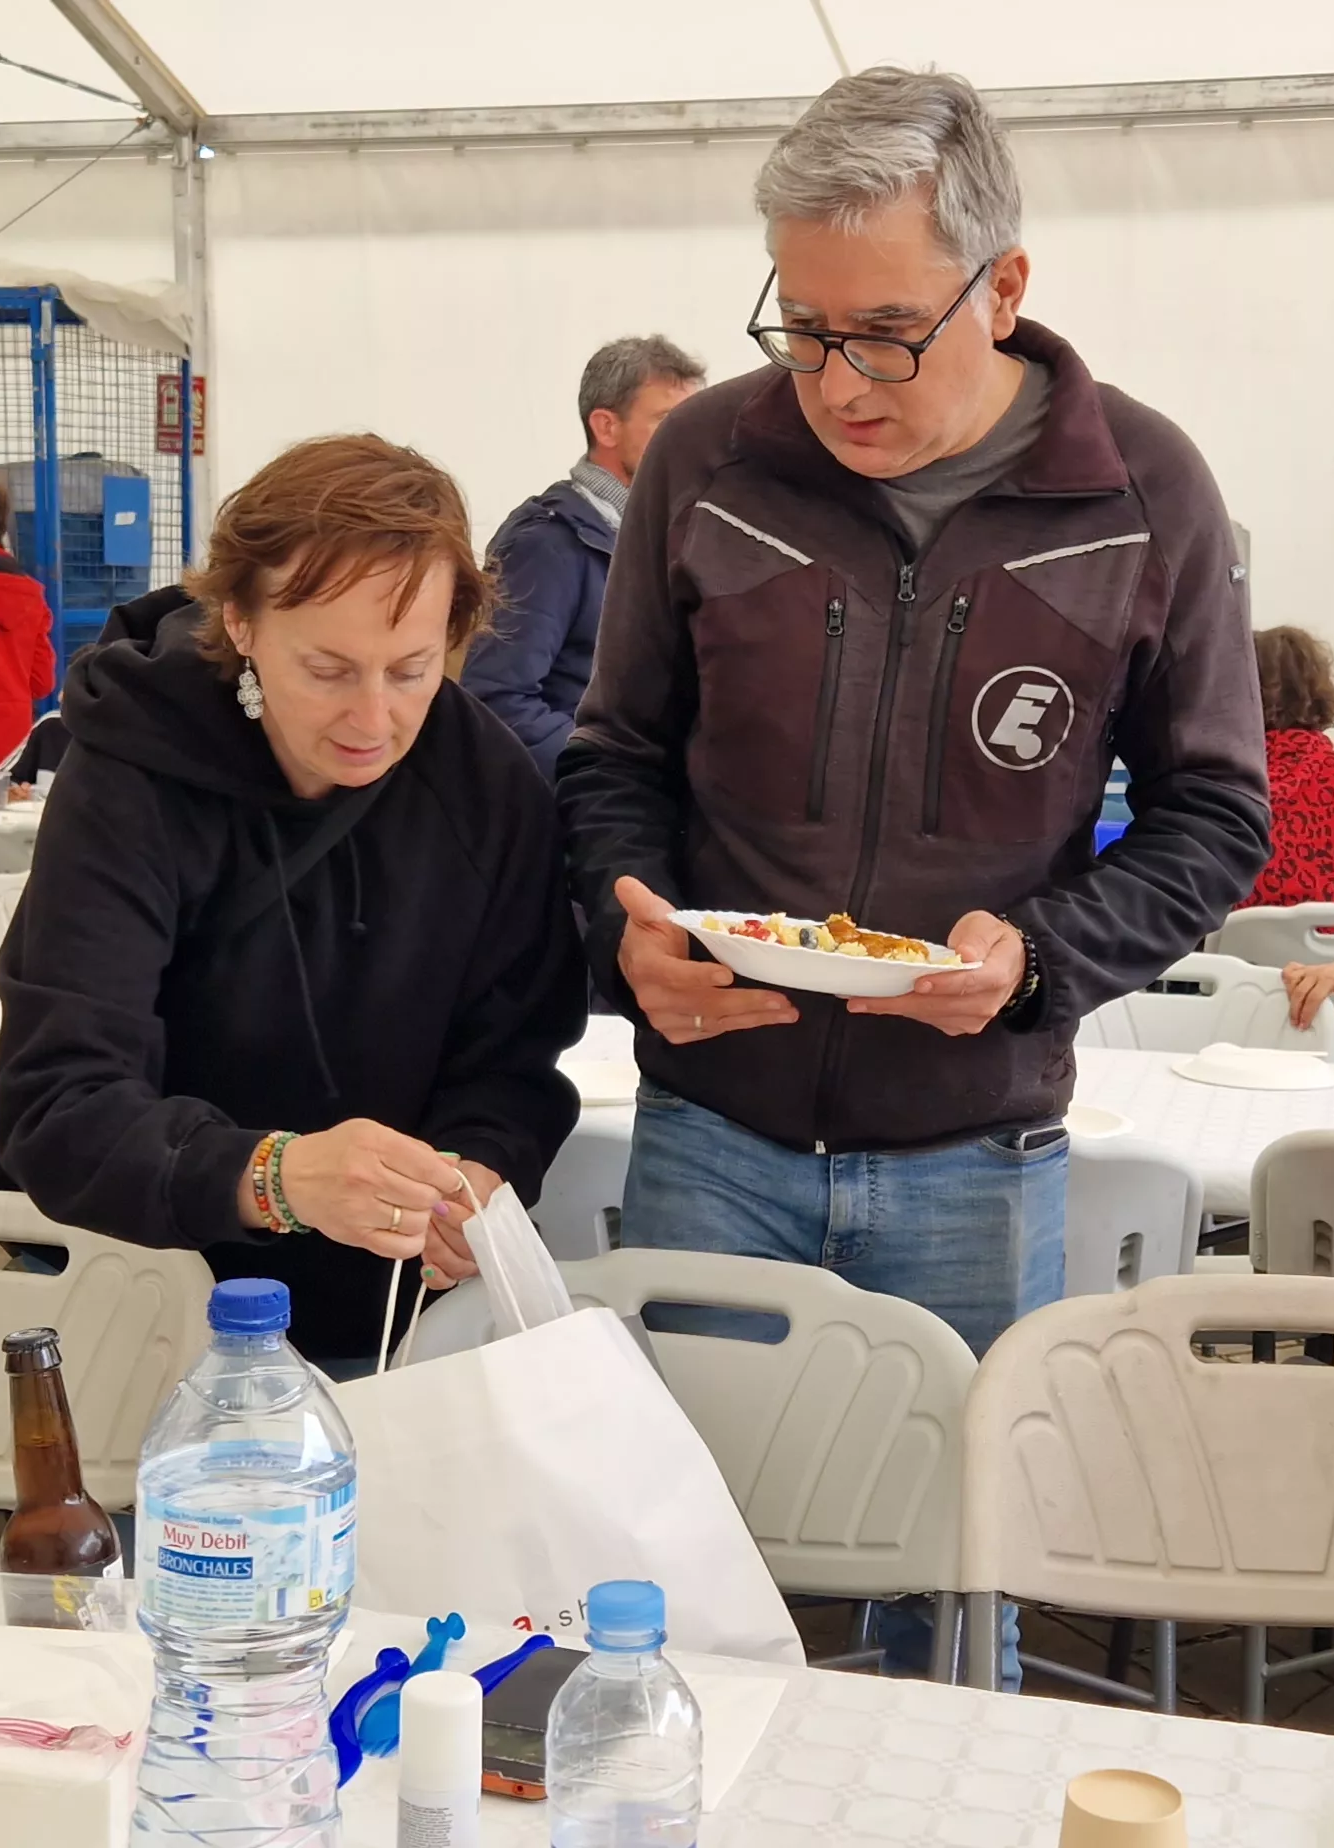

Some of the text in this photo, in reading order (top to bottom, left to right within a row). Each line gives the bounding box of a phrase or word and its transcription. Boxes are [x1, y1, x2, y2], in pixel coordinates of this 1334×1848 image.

[163, 1523, 195, 1549] Muy
[201, 1531, 247, 1549] Débil
[158, 1551, 252, 1576] BRONCHALES
